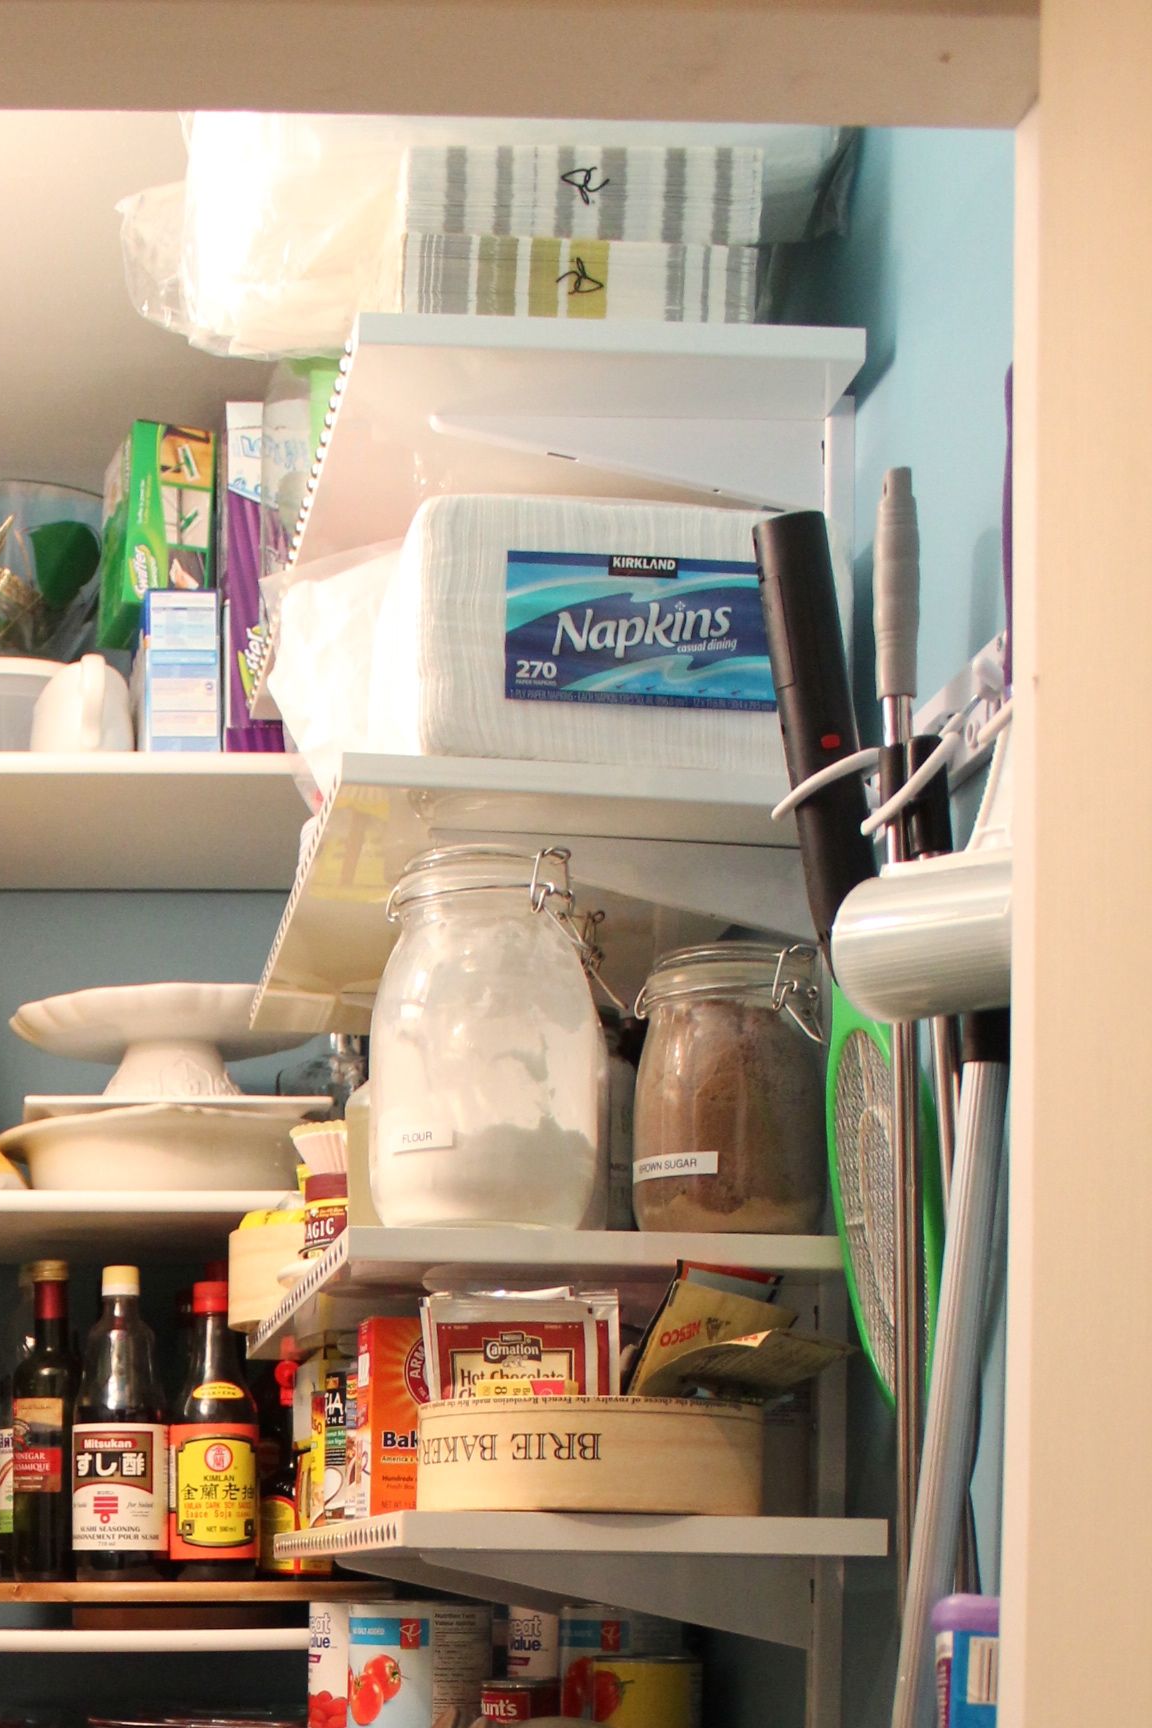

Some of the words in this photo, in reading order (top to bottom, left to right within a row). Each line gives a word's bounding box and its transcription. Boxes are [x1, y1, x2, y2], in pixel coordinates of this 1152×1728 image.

[611, 556, 677, 571] KIRKLAND
[551, 601, 733, 659] Napkins
[676, 641, 706, 654] casual
[706, 637, 738, 652] dining
[515, 660, 558, 679] 270
[528, 689, 546, 699] PAPER
[401, 1130, 434, 1144] FLOUR
[638, 1162, 663, 1175] BROWN
[664, 1158, 697, 1170] SUGAR
[306, 1217, 335, 1240] AGIC
[485, 1341, 540, 1360] Carnation
[460, 1368, 486, 1387] Hot
[492, 1397, 539, 1405] Revolution
[541, 1396, 573, 1404] French
[631, 1397, 641, 1405] of
[643, 1397, 673, 1406] cheese
[83, 1438, 132, 1449] Mitsukan
[381, 1430, 419, 1449] Bak
[509, 1432, 602, 1461] BRIE
[14, 1452, 46, 1461] INEGAR
[422, 1434, 499, 1465] BAKER
[76, 1452, 145, 1477] すし酢
[99, 1525, 141, 1533] SEASONING
[117, 1533, 139, 1541] POUR
[309, 1612, 332, 1635] eat
[512, 1615, 542, 1638] eat
[510, 1637, 541, 1652] alue
